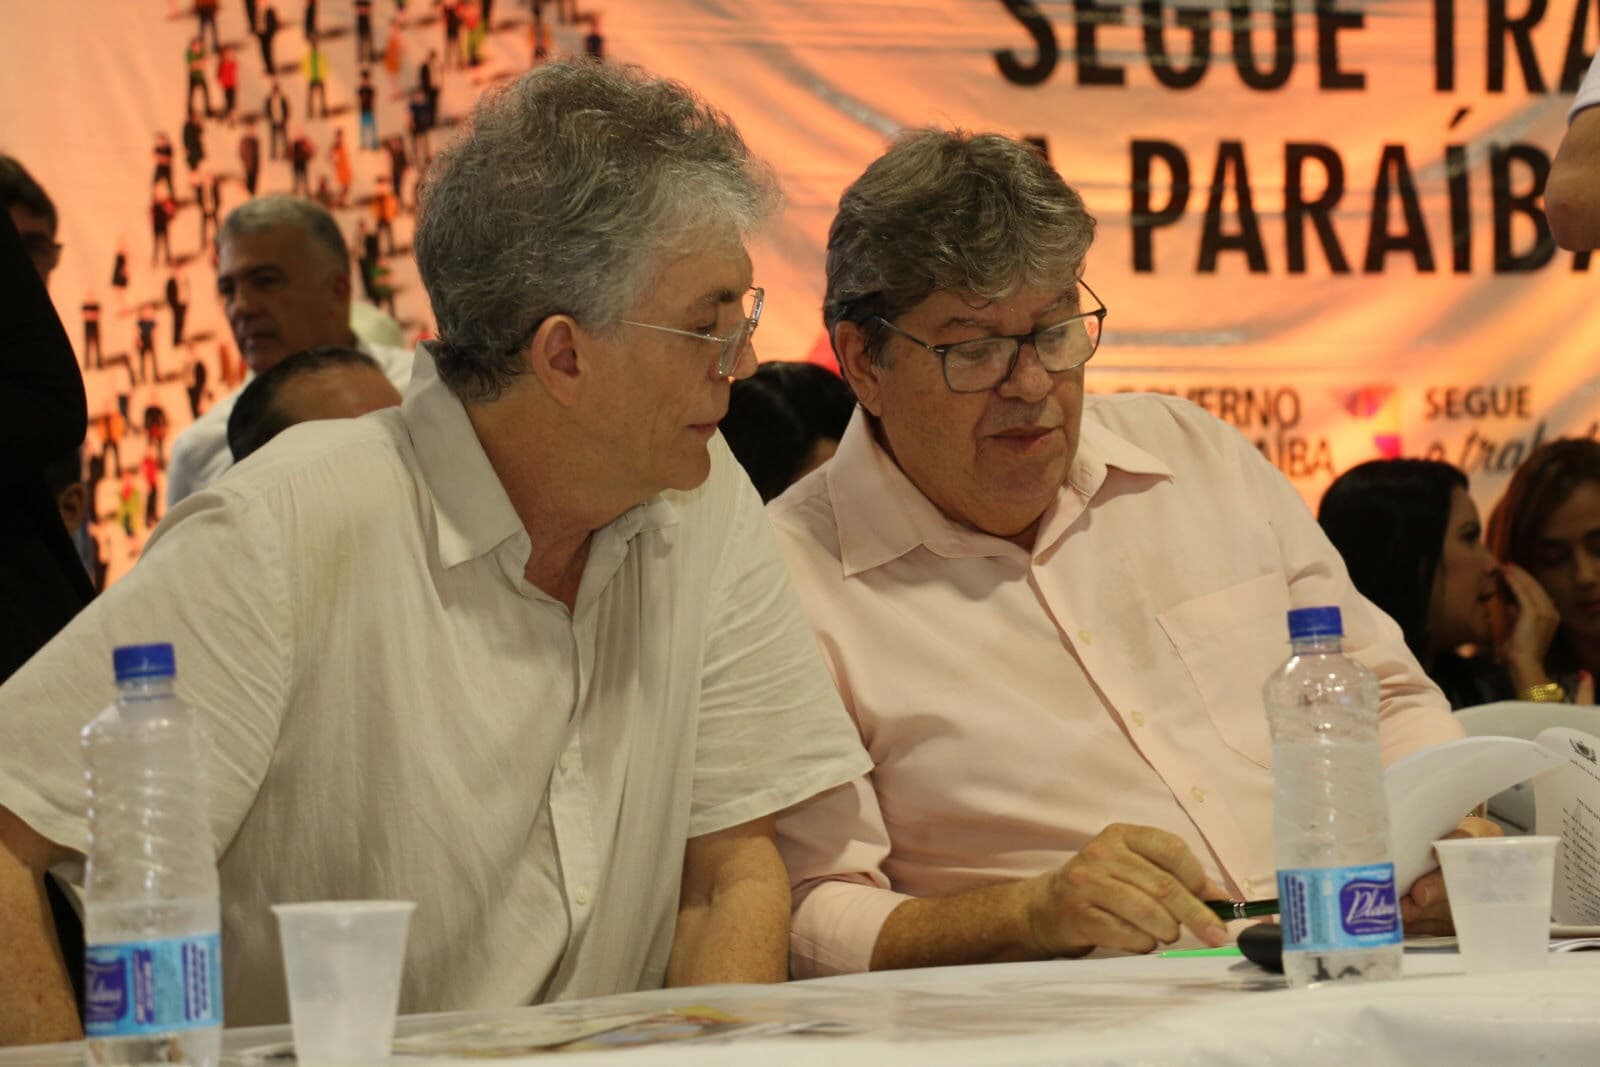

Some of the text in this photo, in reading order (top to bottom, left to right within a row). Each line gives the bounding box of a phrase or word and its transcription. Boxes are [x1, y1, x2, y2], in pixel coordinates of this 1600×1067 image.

[994, 0, 1365, 91] SEGUE
[1129, 107, 1592, 274] PARAÍB
[1424, 385, 1531, 419] SEGUE
